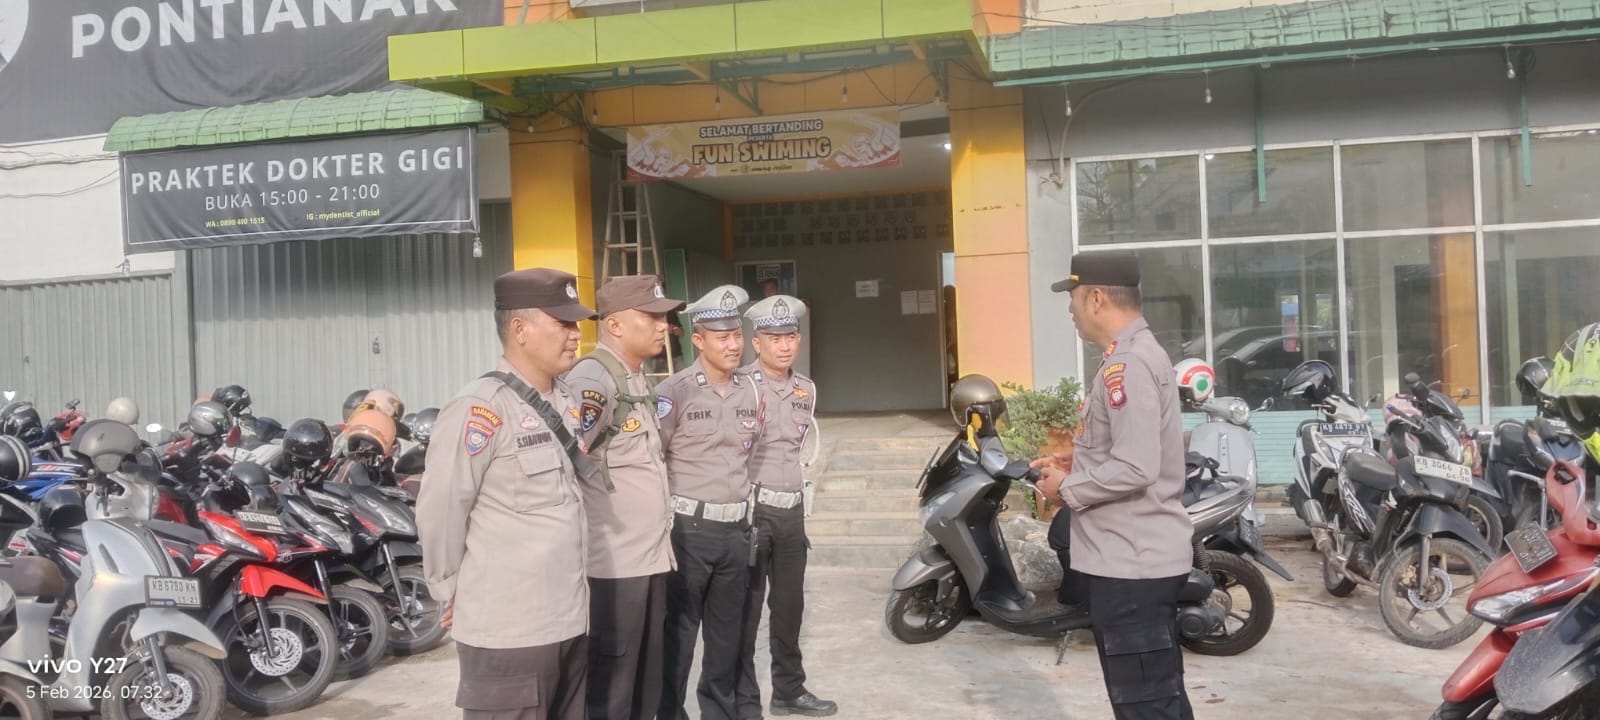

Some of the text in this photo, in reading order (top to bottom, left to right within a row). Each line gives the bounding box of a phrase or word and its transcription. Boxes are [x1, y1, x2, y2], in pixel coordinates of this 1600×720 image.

[700, 119, 823, 138] SELAMAT BERTANDING
[692, 136, 832, 165] FUN SWIMING
[131, 146, 463, 194] PRAKTEK DOKTER GIGI
[205, 193, 252, 211] BUKA
[259, 188, 308, 207] 15:00
[329, 184, 380, 202] 21:00
[583, 391, 605, 403] SPKT
[687, 410, 712, 421] ERIK
[1416, 457, 1428, 466] KB
[152, 579, 163, 591] KB
